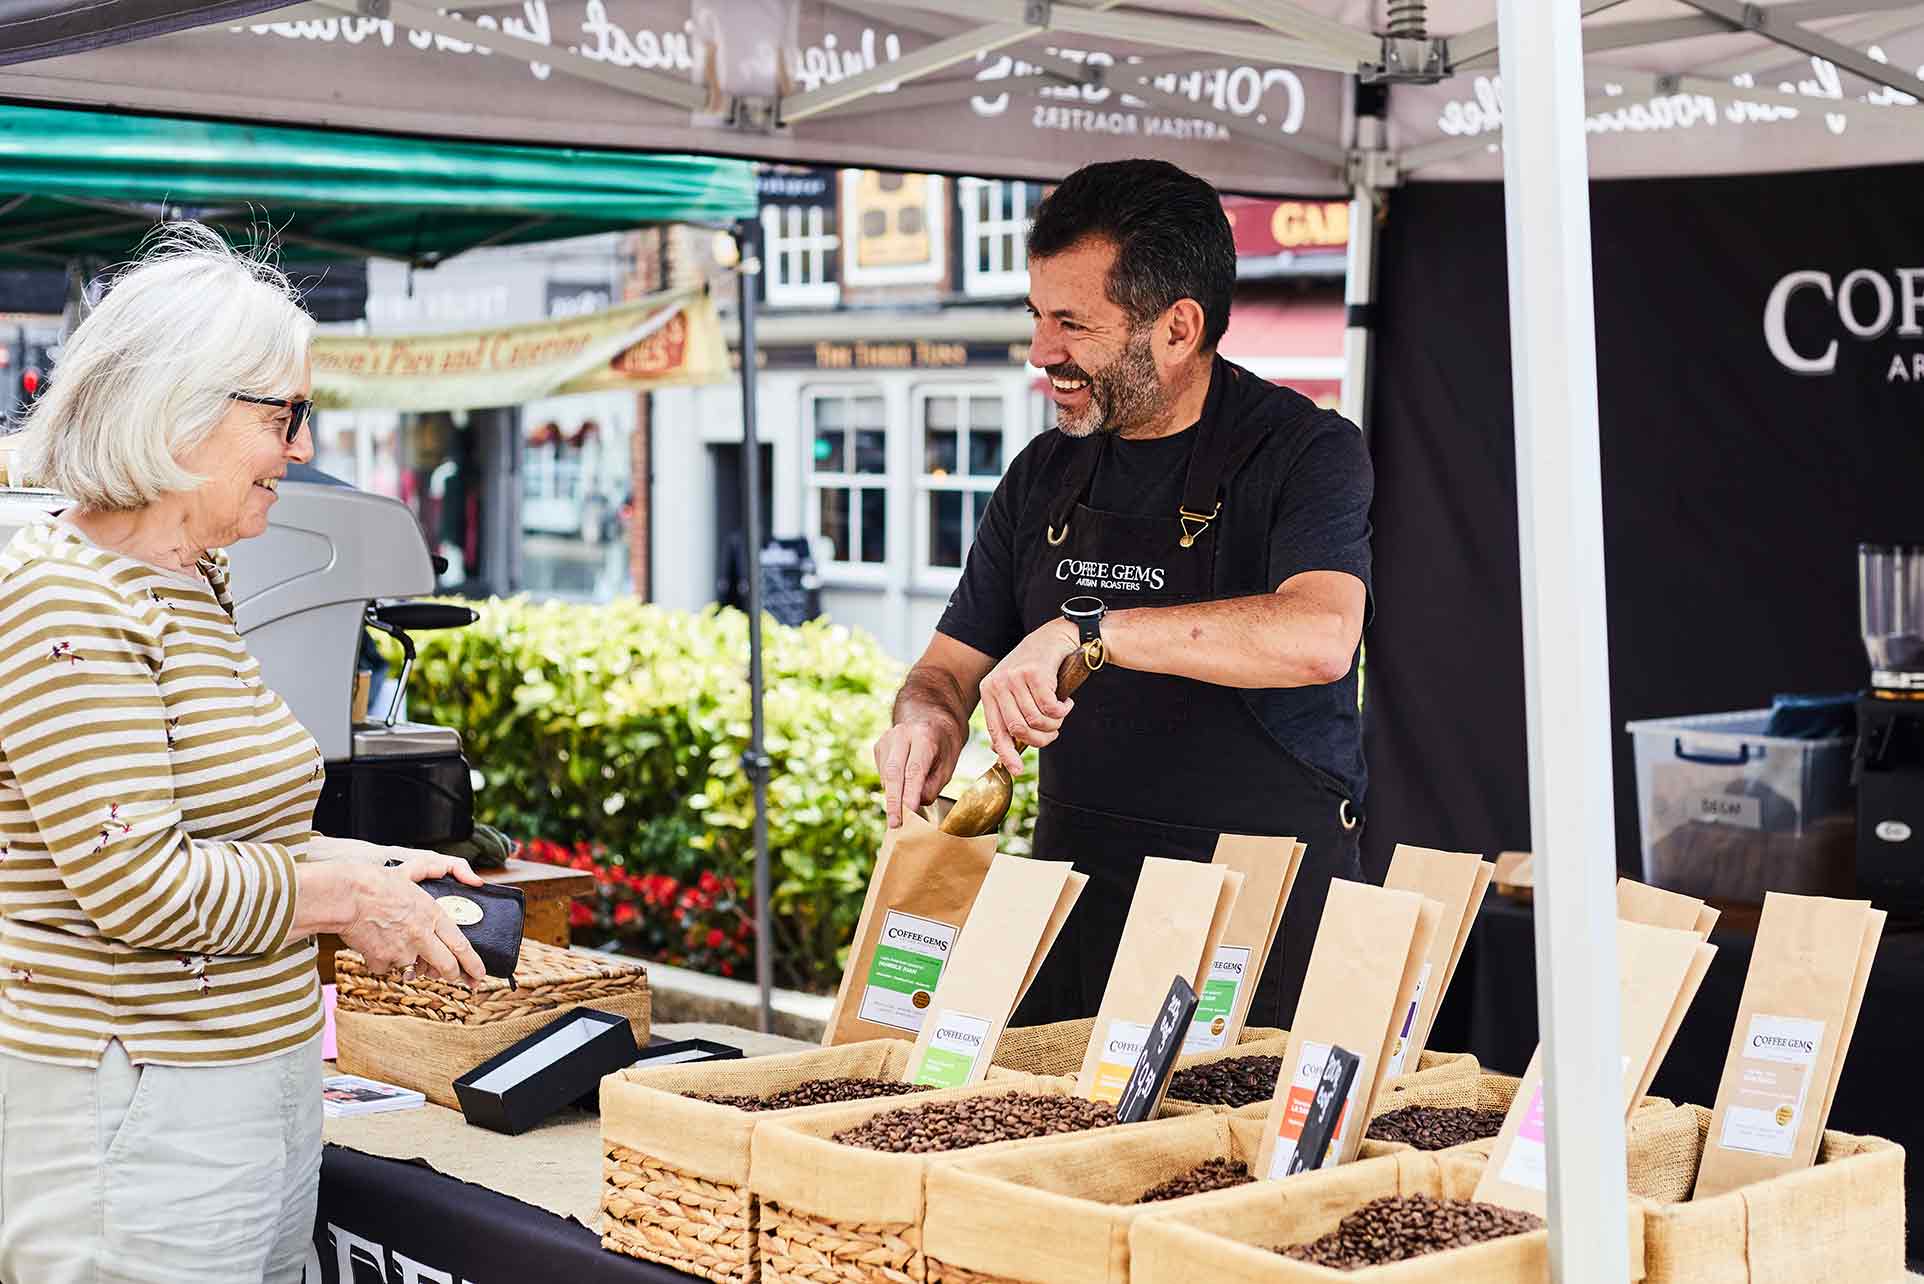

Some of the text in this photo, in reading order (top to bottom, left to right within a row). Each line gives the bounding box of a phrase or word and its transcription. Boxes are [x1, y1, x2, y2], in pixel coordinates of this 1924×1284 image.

[1100, 580, 1141, 591] ROASTERS
[1111, 564, 1165, 590] GEMS
[888, 927, 923, 944] COFFEE
[923, 935, 949, 952] GEMS
[1752, 1034, 1814, 1054] COFFEE GEMS
